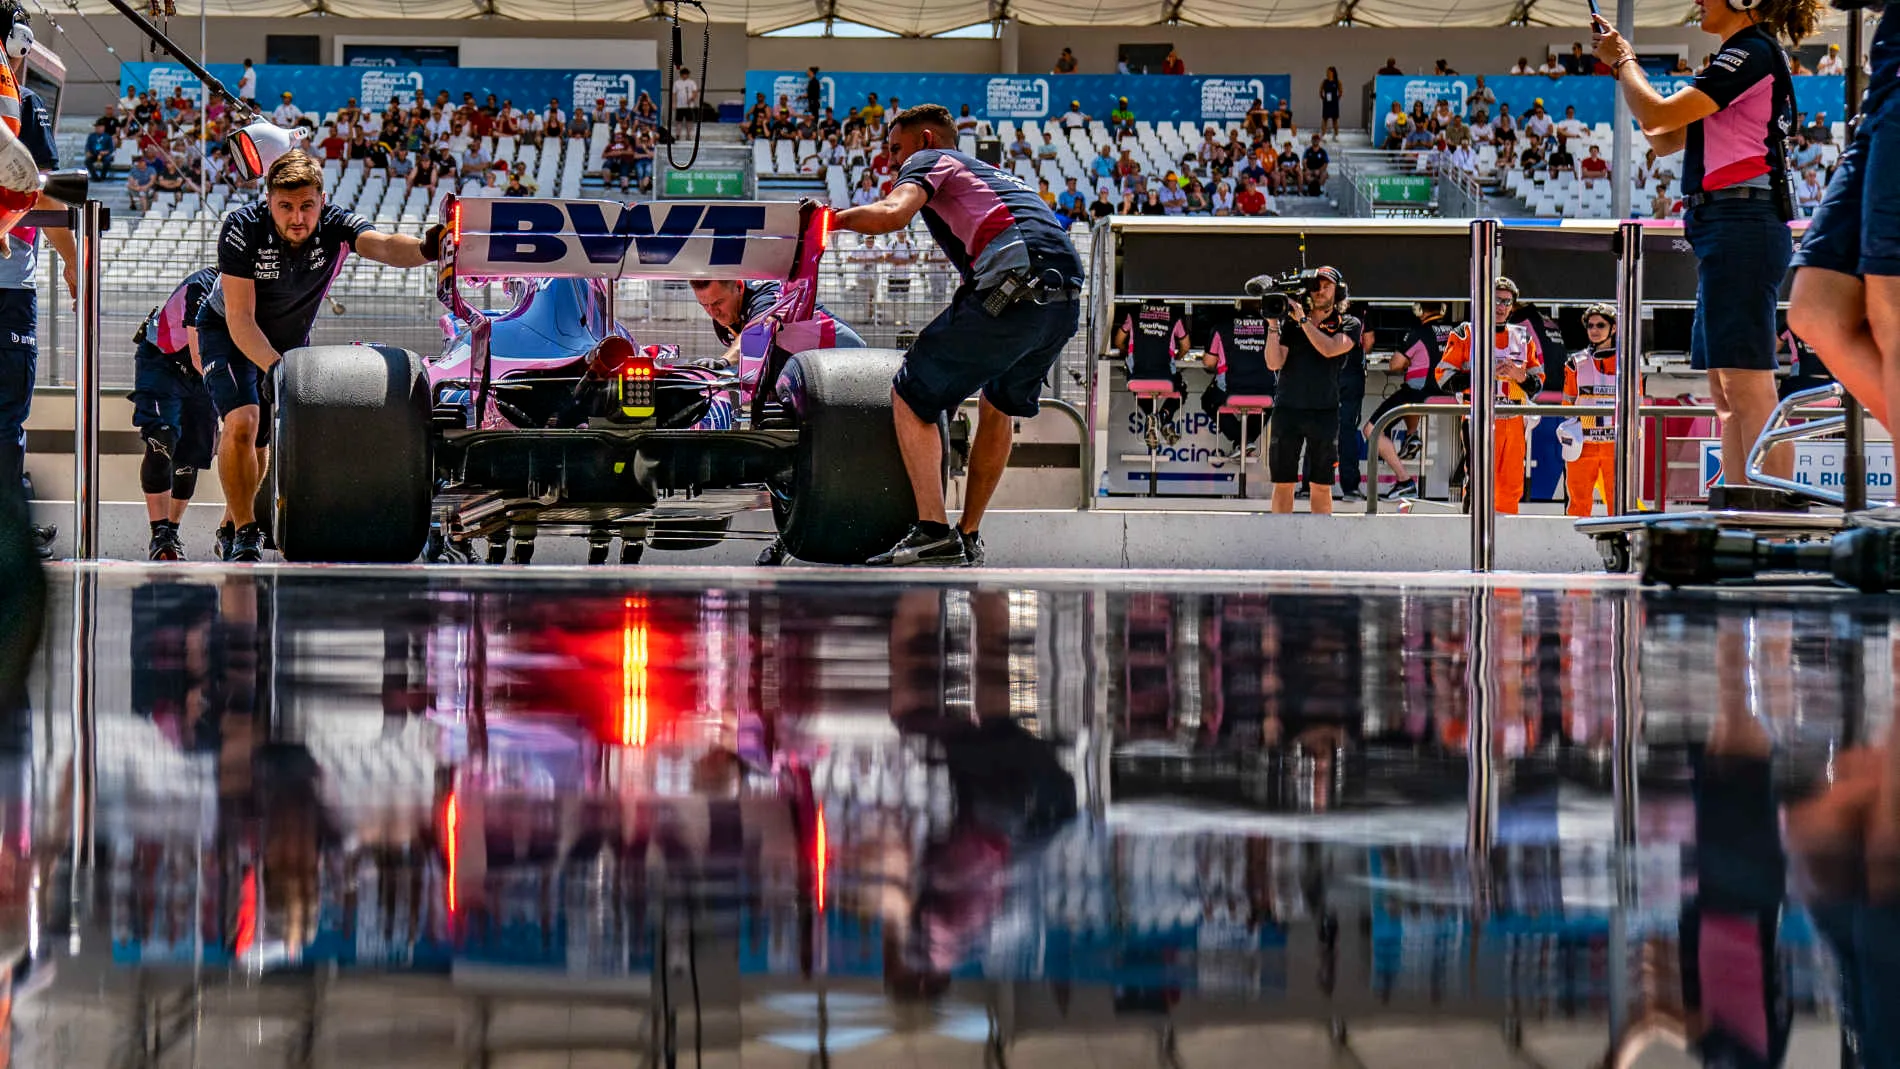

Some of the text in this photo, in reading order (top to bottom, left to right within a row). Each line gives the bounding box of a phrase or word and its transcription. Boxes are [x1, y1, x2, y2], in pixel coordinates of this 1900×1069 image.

[1380, 177, 1391, 185] DE
[1392, 177, 1424, 186] SECOURS
[488, 202, 766, 265] BWT
[255, 262, 281, 270] NEC
[1820, 472, 1892, 486] RICRD
